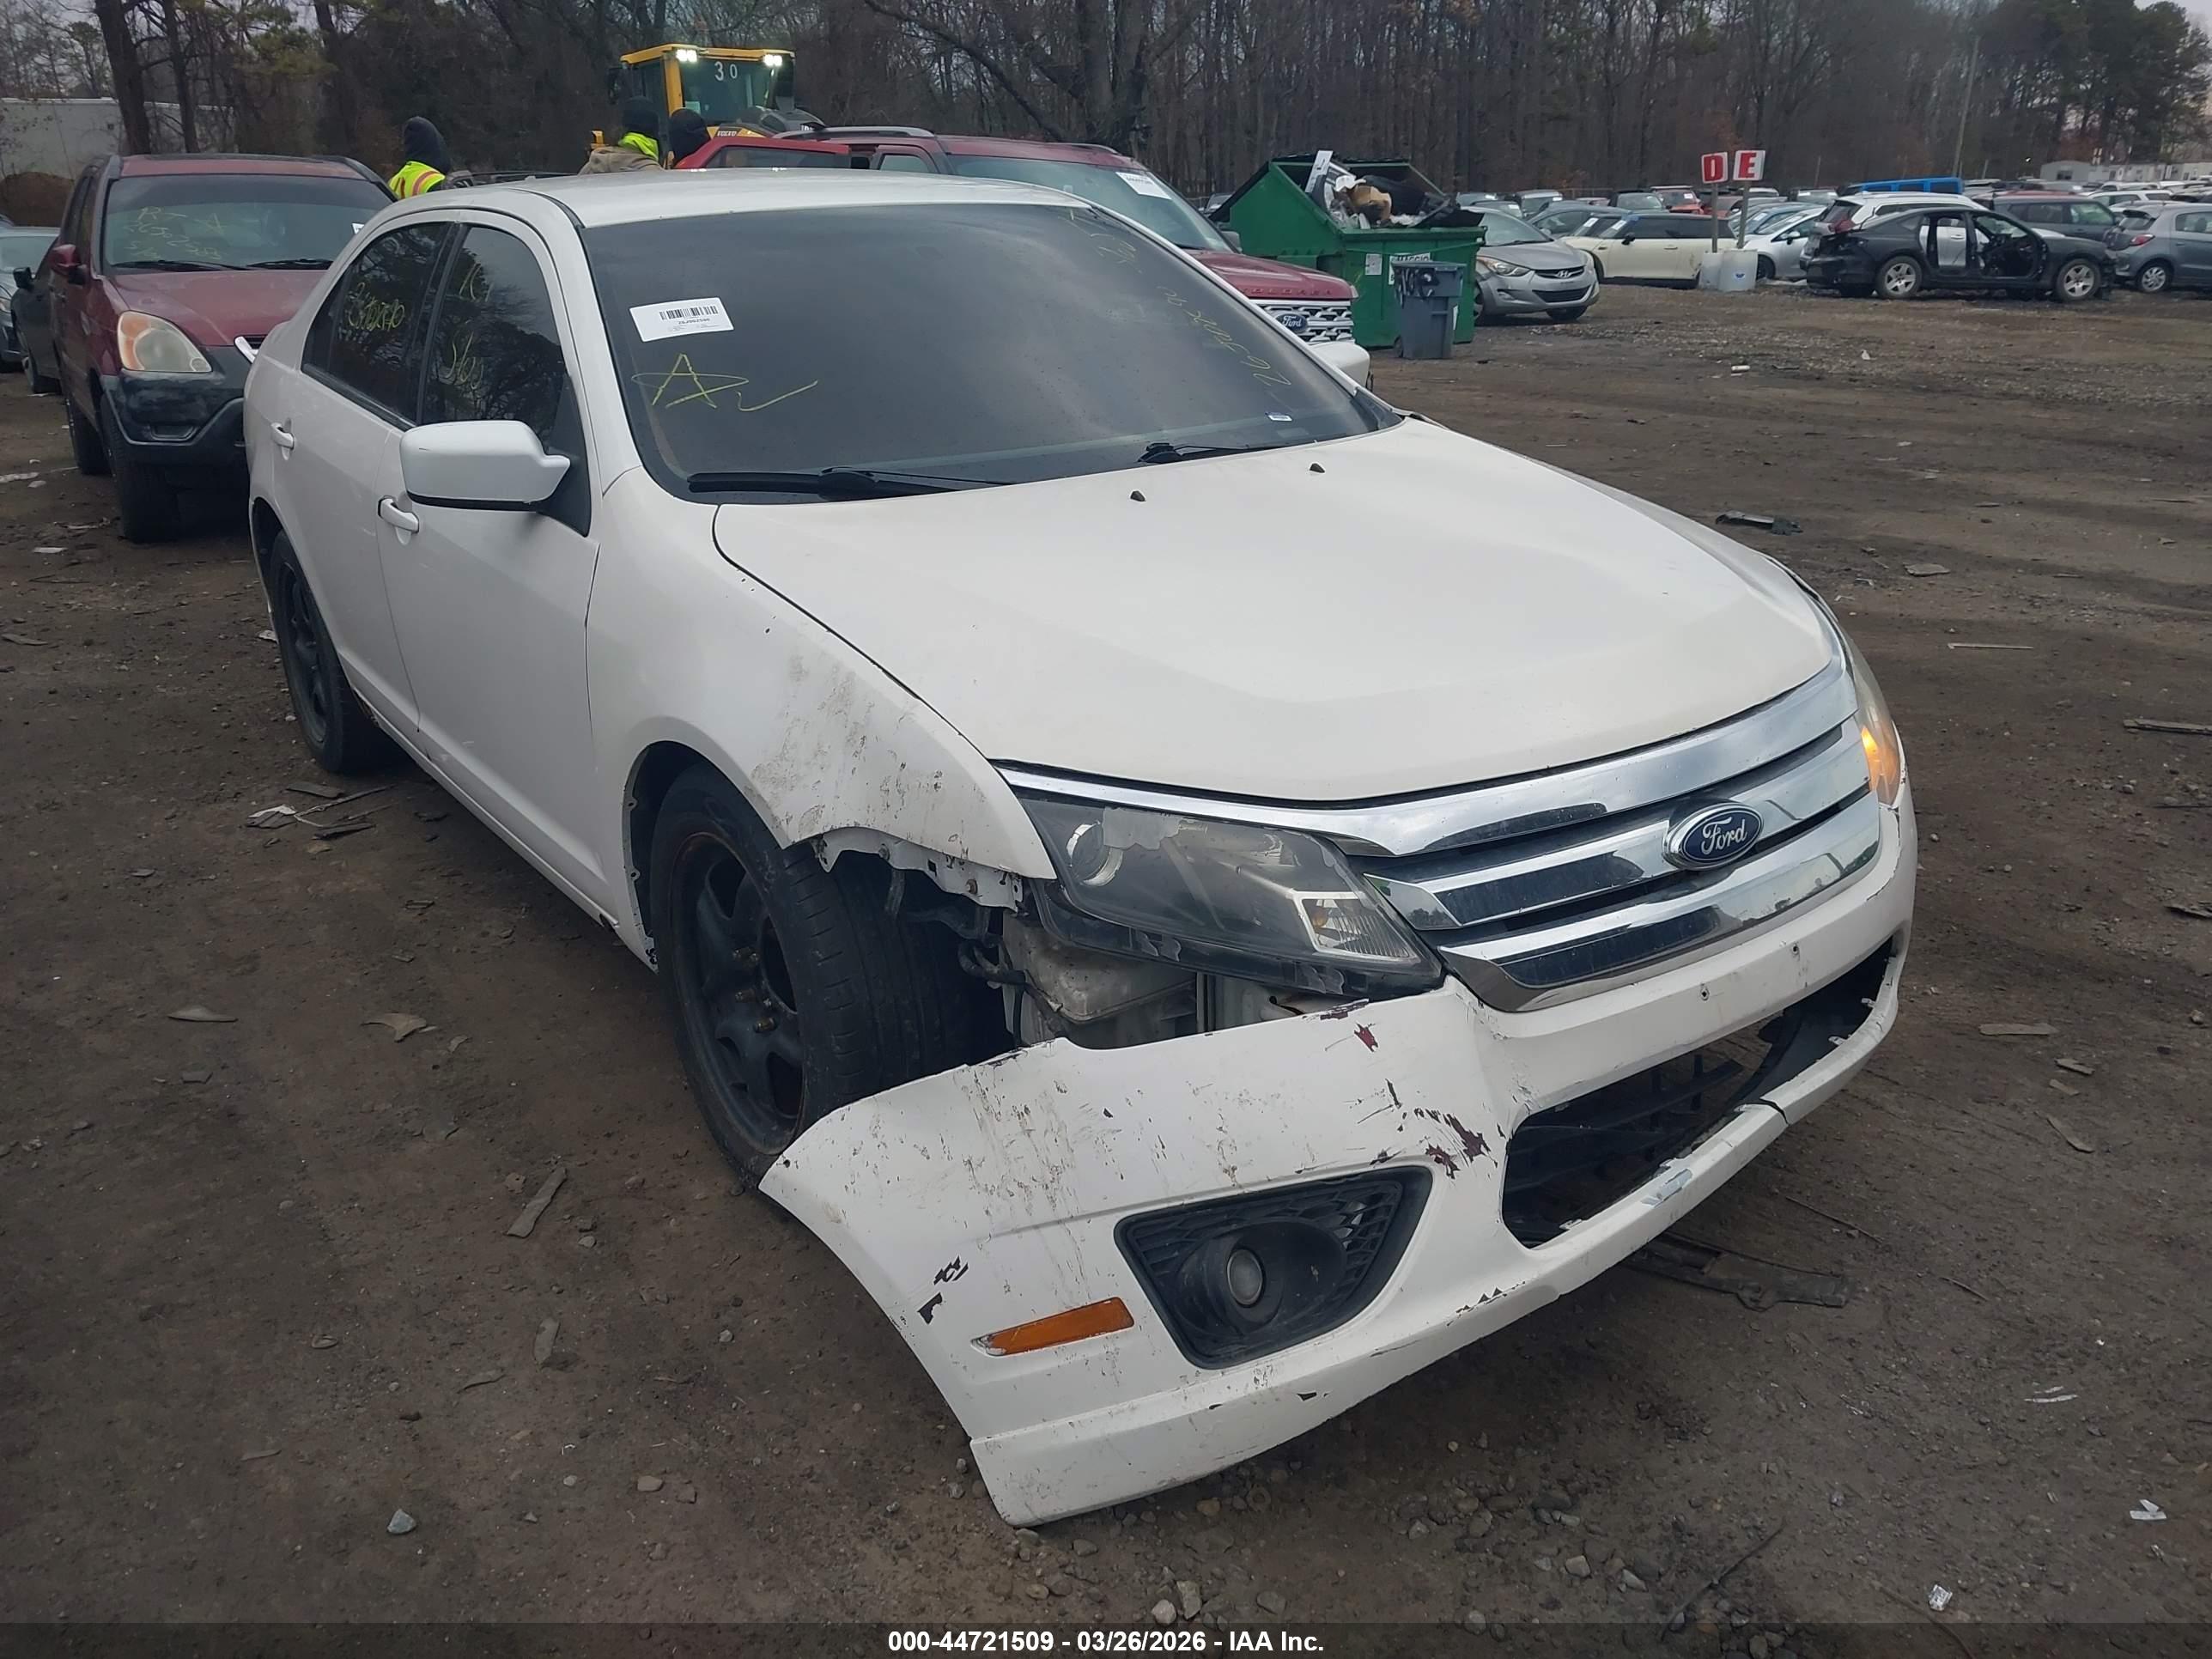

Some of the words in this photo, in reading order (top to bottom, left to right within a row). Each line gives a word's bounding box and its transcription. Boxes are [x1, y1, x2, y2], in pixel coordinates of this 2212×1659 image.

[714, 61, 738, 82] 30
[1738, 153, 1757, 179] E
[1282, 315, 1302, 328] Ford
[1701, 817, 1747, 855] Ford
